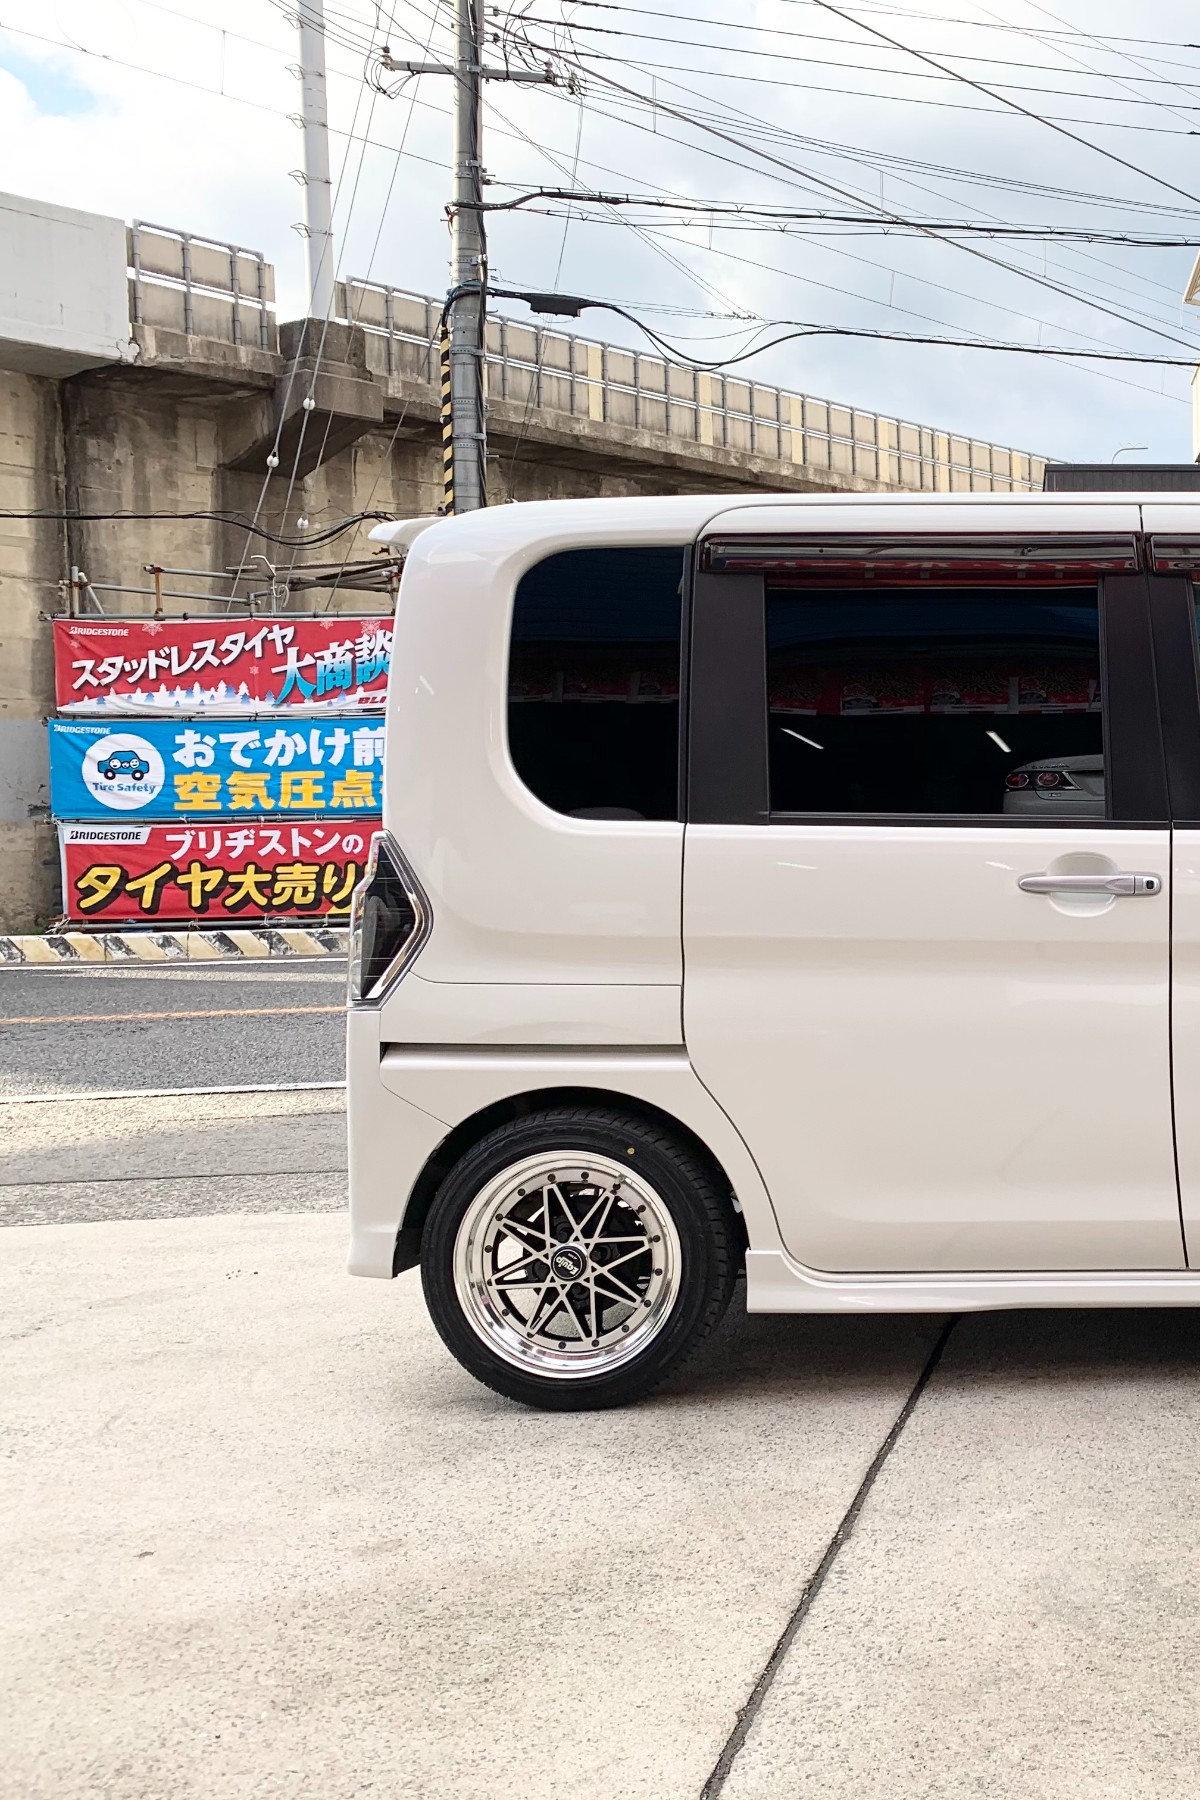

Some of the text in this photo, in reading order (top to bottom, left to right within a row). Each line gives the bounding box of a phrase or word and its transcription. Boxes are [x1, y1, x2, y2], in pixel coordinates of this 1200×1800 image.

[69, 626, 129, 637] BRIDGESTONE
[71, 623, 296, 690] スタッドレスタイヤ
[271, 629, 394, 707] 大商談
[53, 724, 111, 735] BRIDGESTONE
[172, 726, 386, 768] おでかけ前
[92, 782, 157, 795] Tire Safety
[173, 771, 384, 811] 空気圧点
[69, 830, 141, 841] BRIDGESTONE
[165, 829, 364, 861] ブリヂストンの
[76, 862, 364, 912] タイヤ大売り
[555, 1256, 579, 1275] Equip
